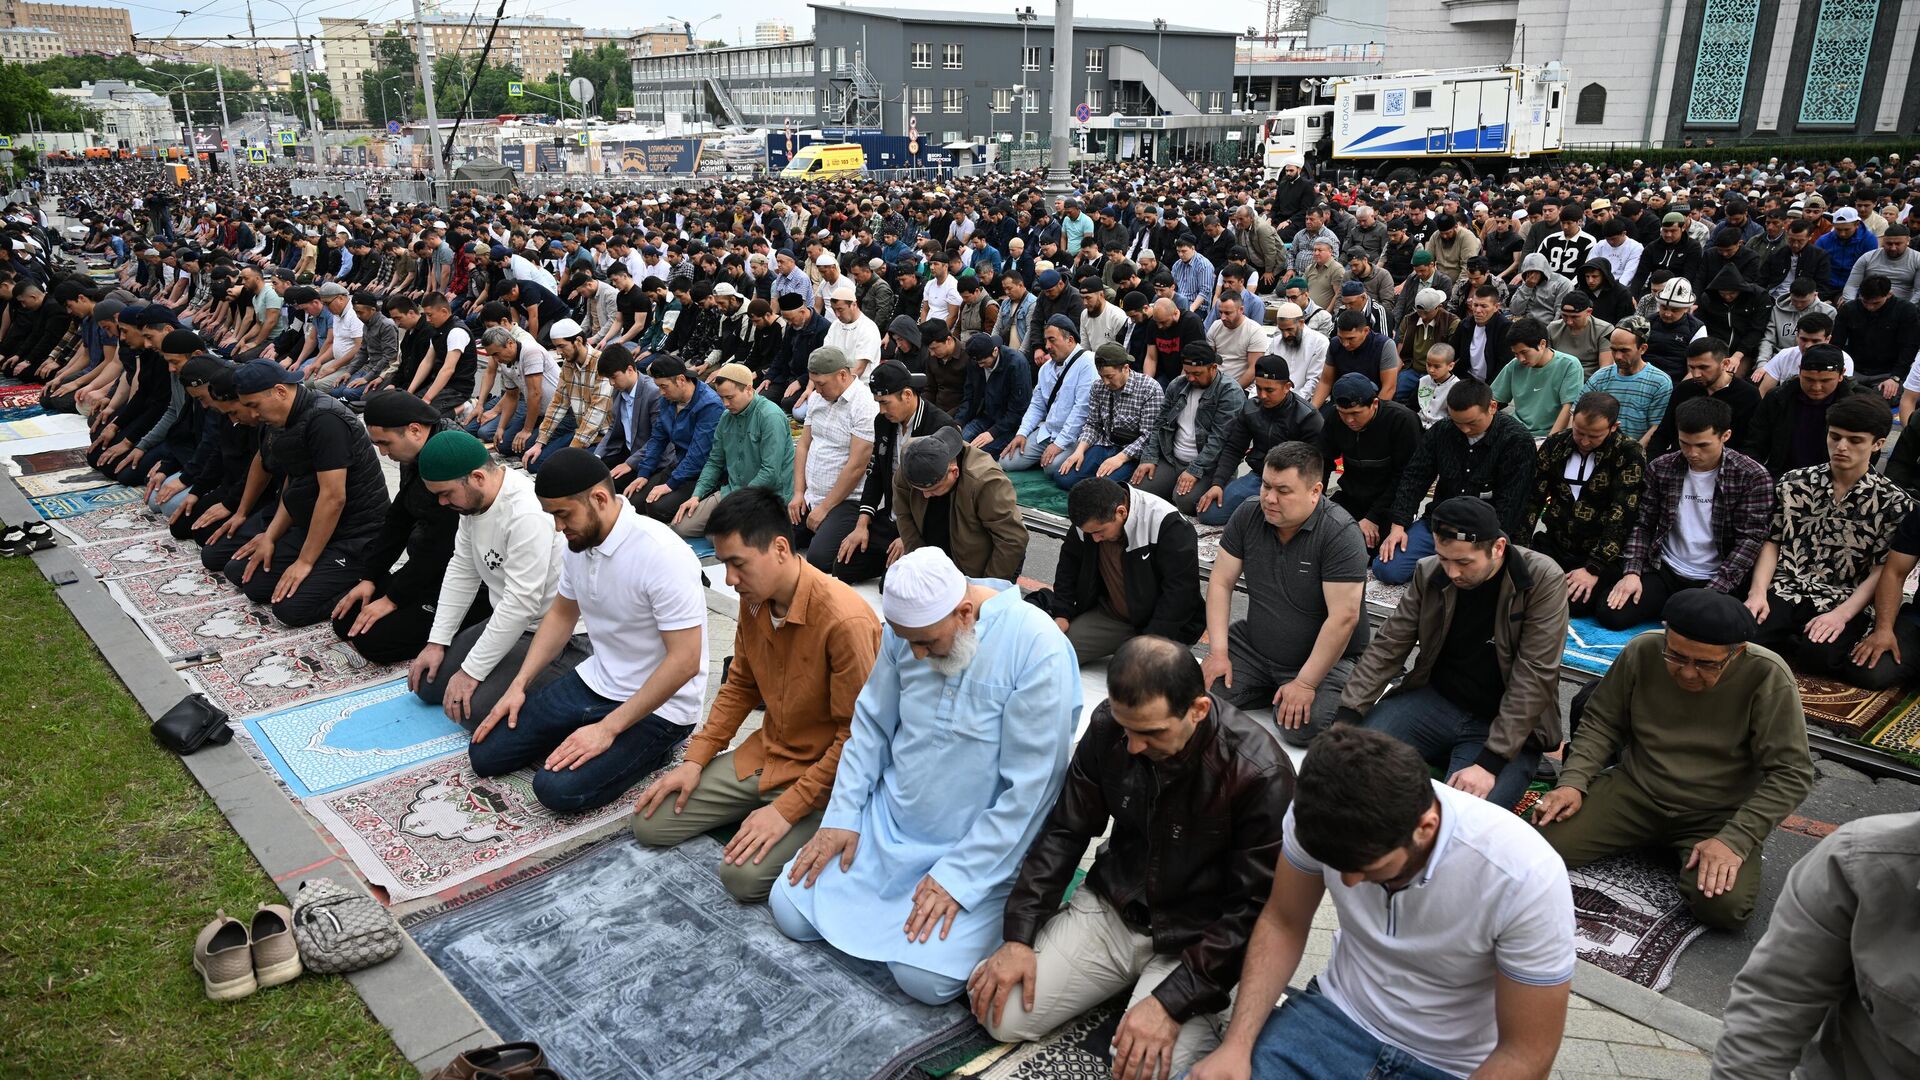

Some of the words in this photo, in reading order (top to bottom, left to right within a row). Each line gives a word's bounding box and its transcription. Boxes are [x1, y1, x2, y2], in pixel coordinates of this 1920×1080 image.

[1342, 96, 1350, 136] RSVO.RU
[1549, 246, 1579, 273] 92
[1782, 322, 1800, 337] GA
